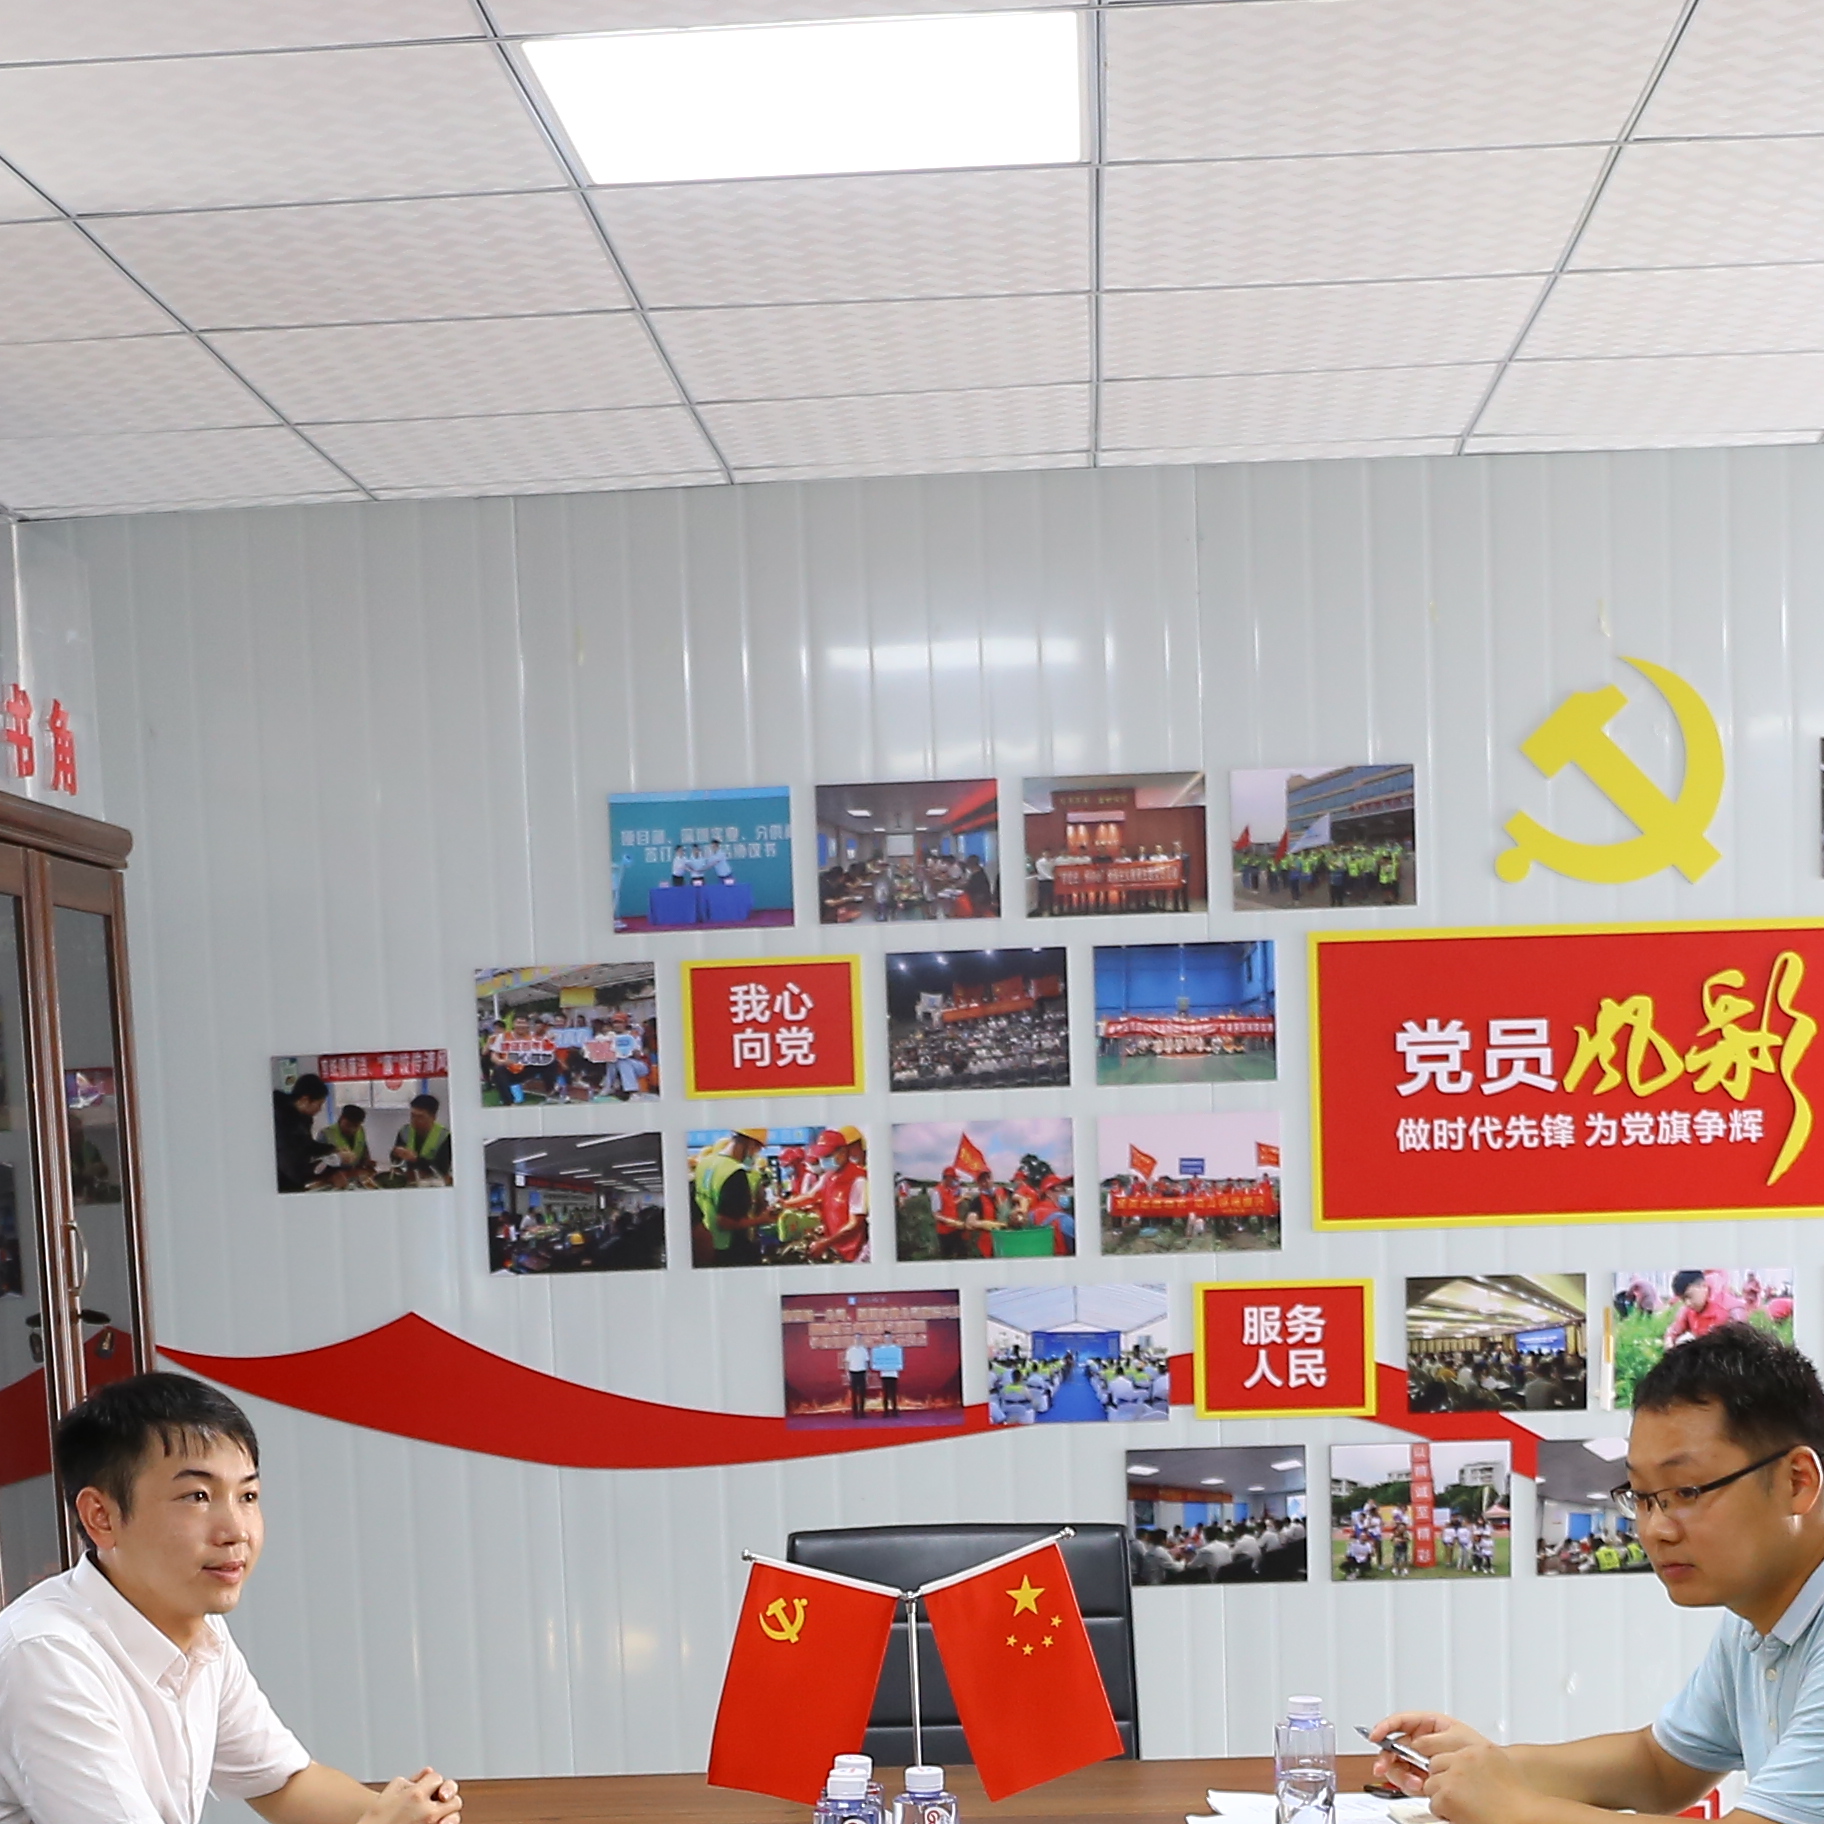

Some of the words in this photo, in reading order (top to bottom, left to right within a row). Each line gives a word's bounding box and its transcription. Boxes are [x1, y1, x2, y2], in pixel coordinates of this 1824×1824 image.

[729, 982, 814, 1025] 我心
[731, 1025, 817, 1069] 向党
[1395, 1115, 1576, 1153] 做时代先锋
[1584, 1108, 1766, 1149] 为党旗争辉
[1241, 1304, 1328, 1346] 服务
[1243, 1347, 1329, 1389] 人民
